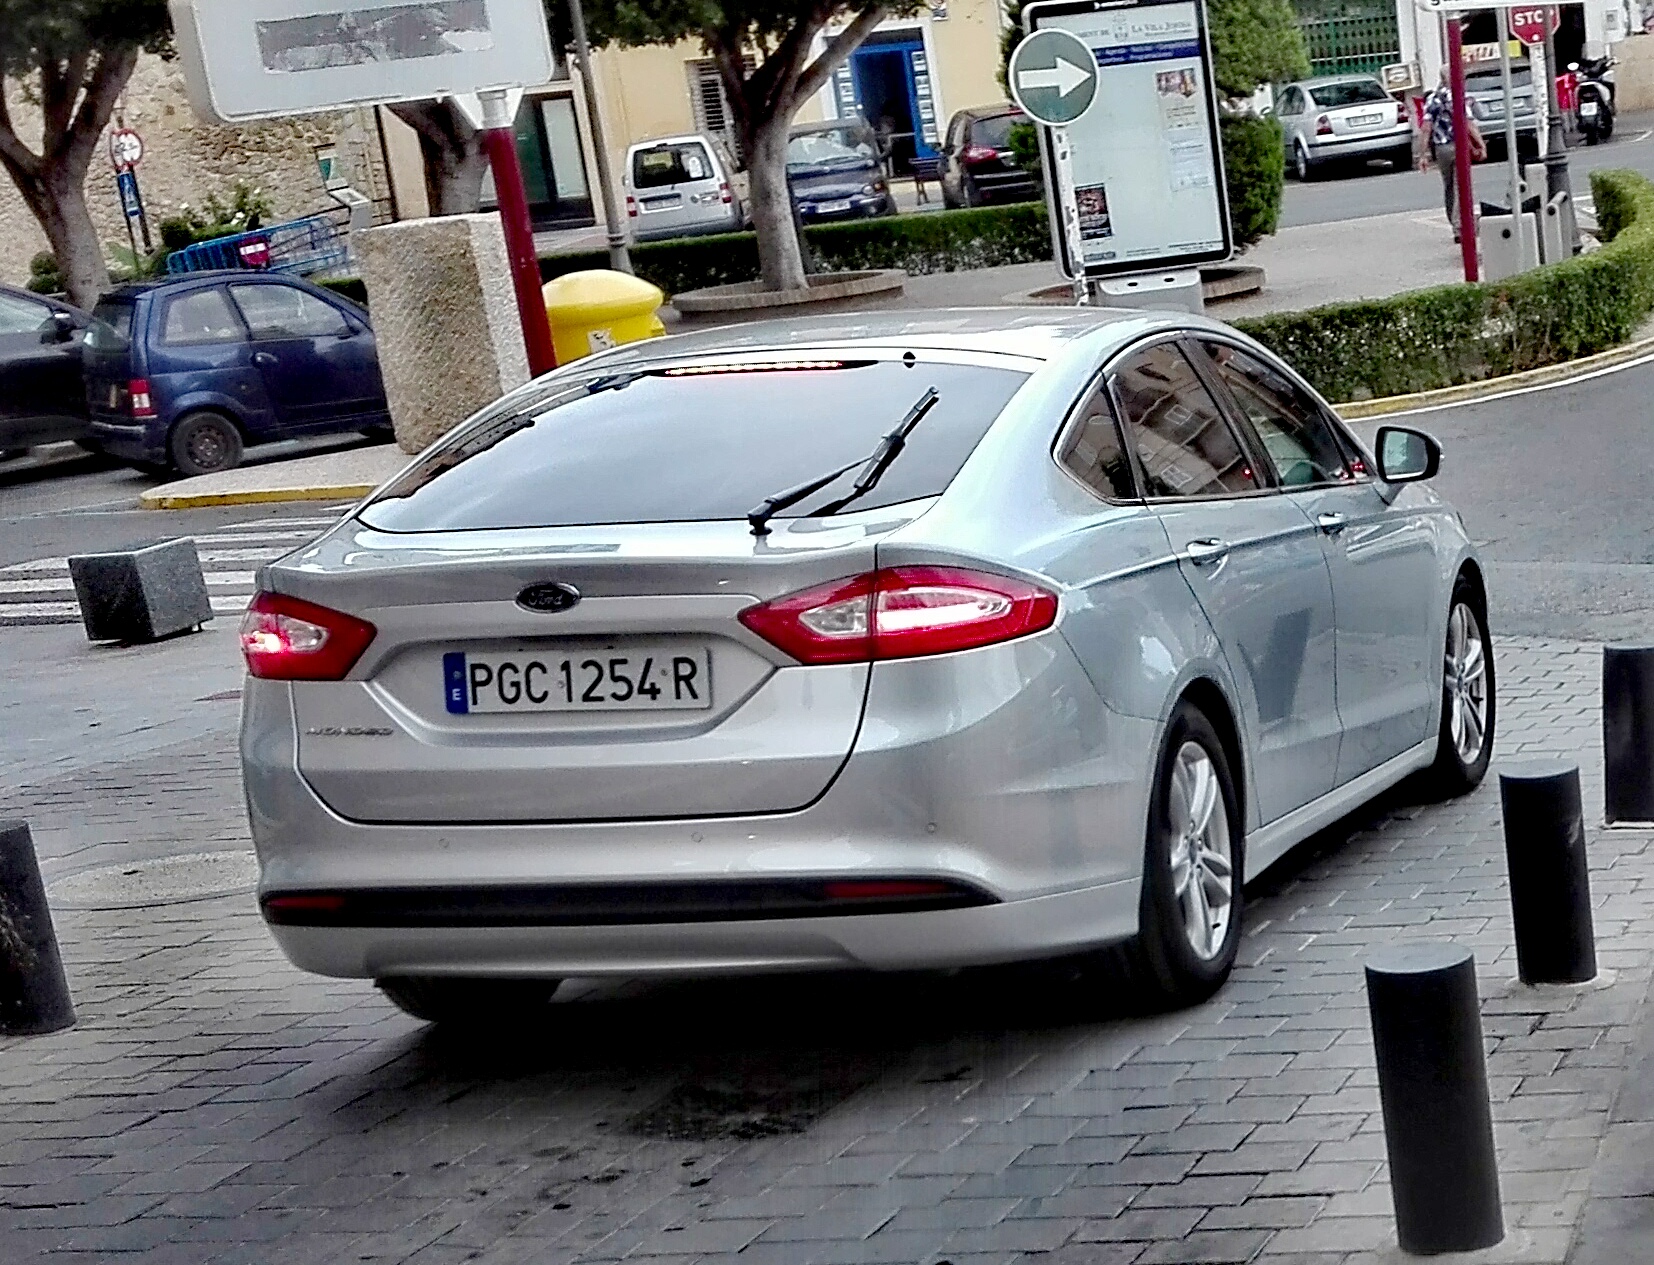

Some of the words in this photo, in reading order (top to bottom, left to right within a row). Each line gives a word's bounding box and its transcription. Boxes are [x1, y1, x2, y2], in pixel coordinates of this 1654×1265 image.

[1513, 9, 1556, 26] STO
[470, 662, 549, 705] PGC
[560, 657, 662, 703] 1254
[673, 656, 699, 700] R
[451, 688, 461, 701] E
